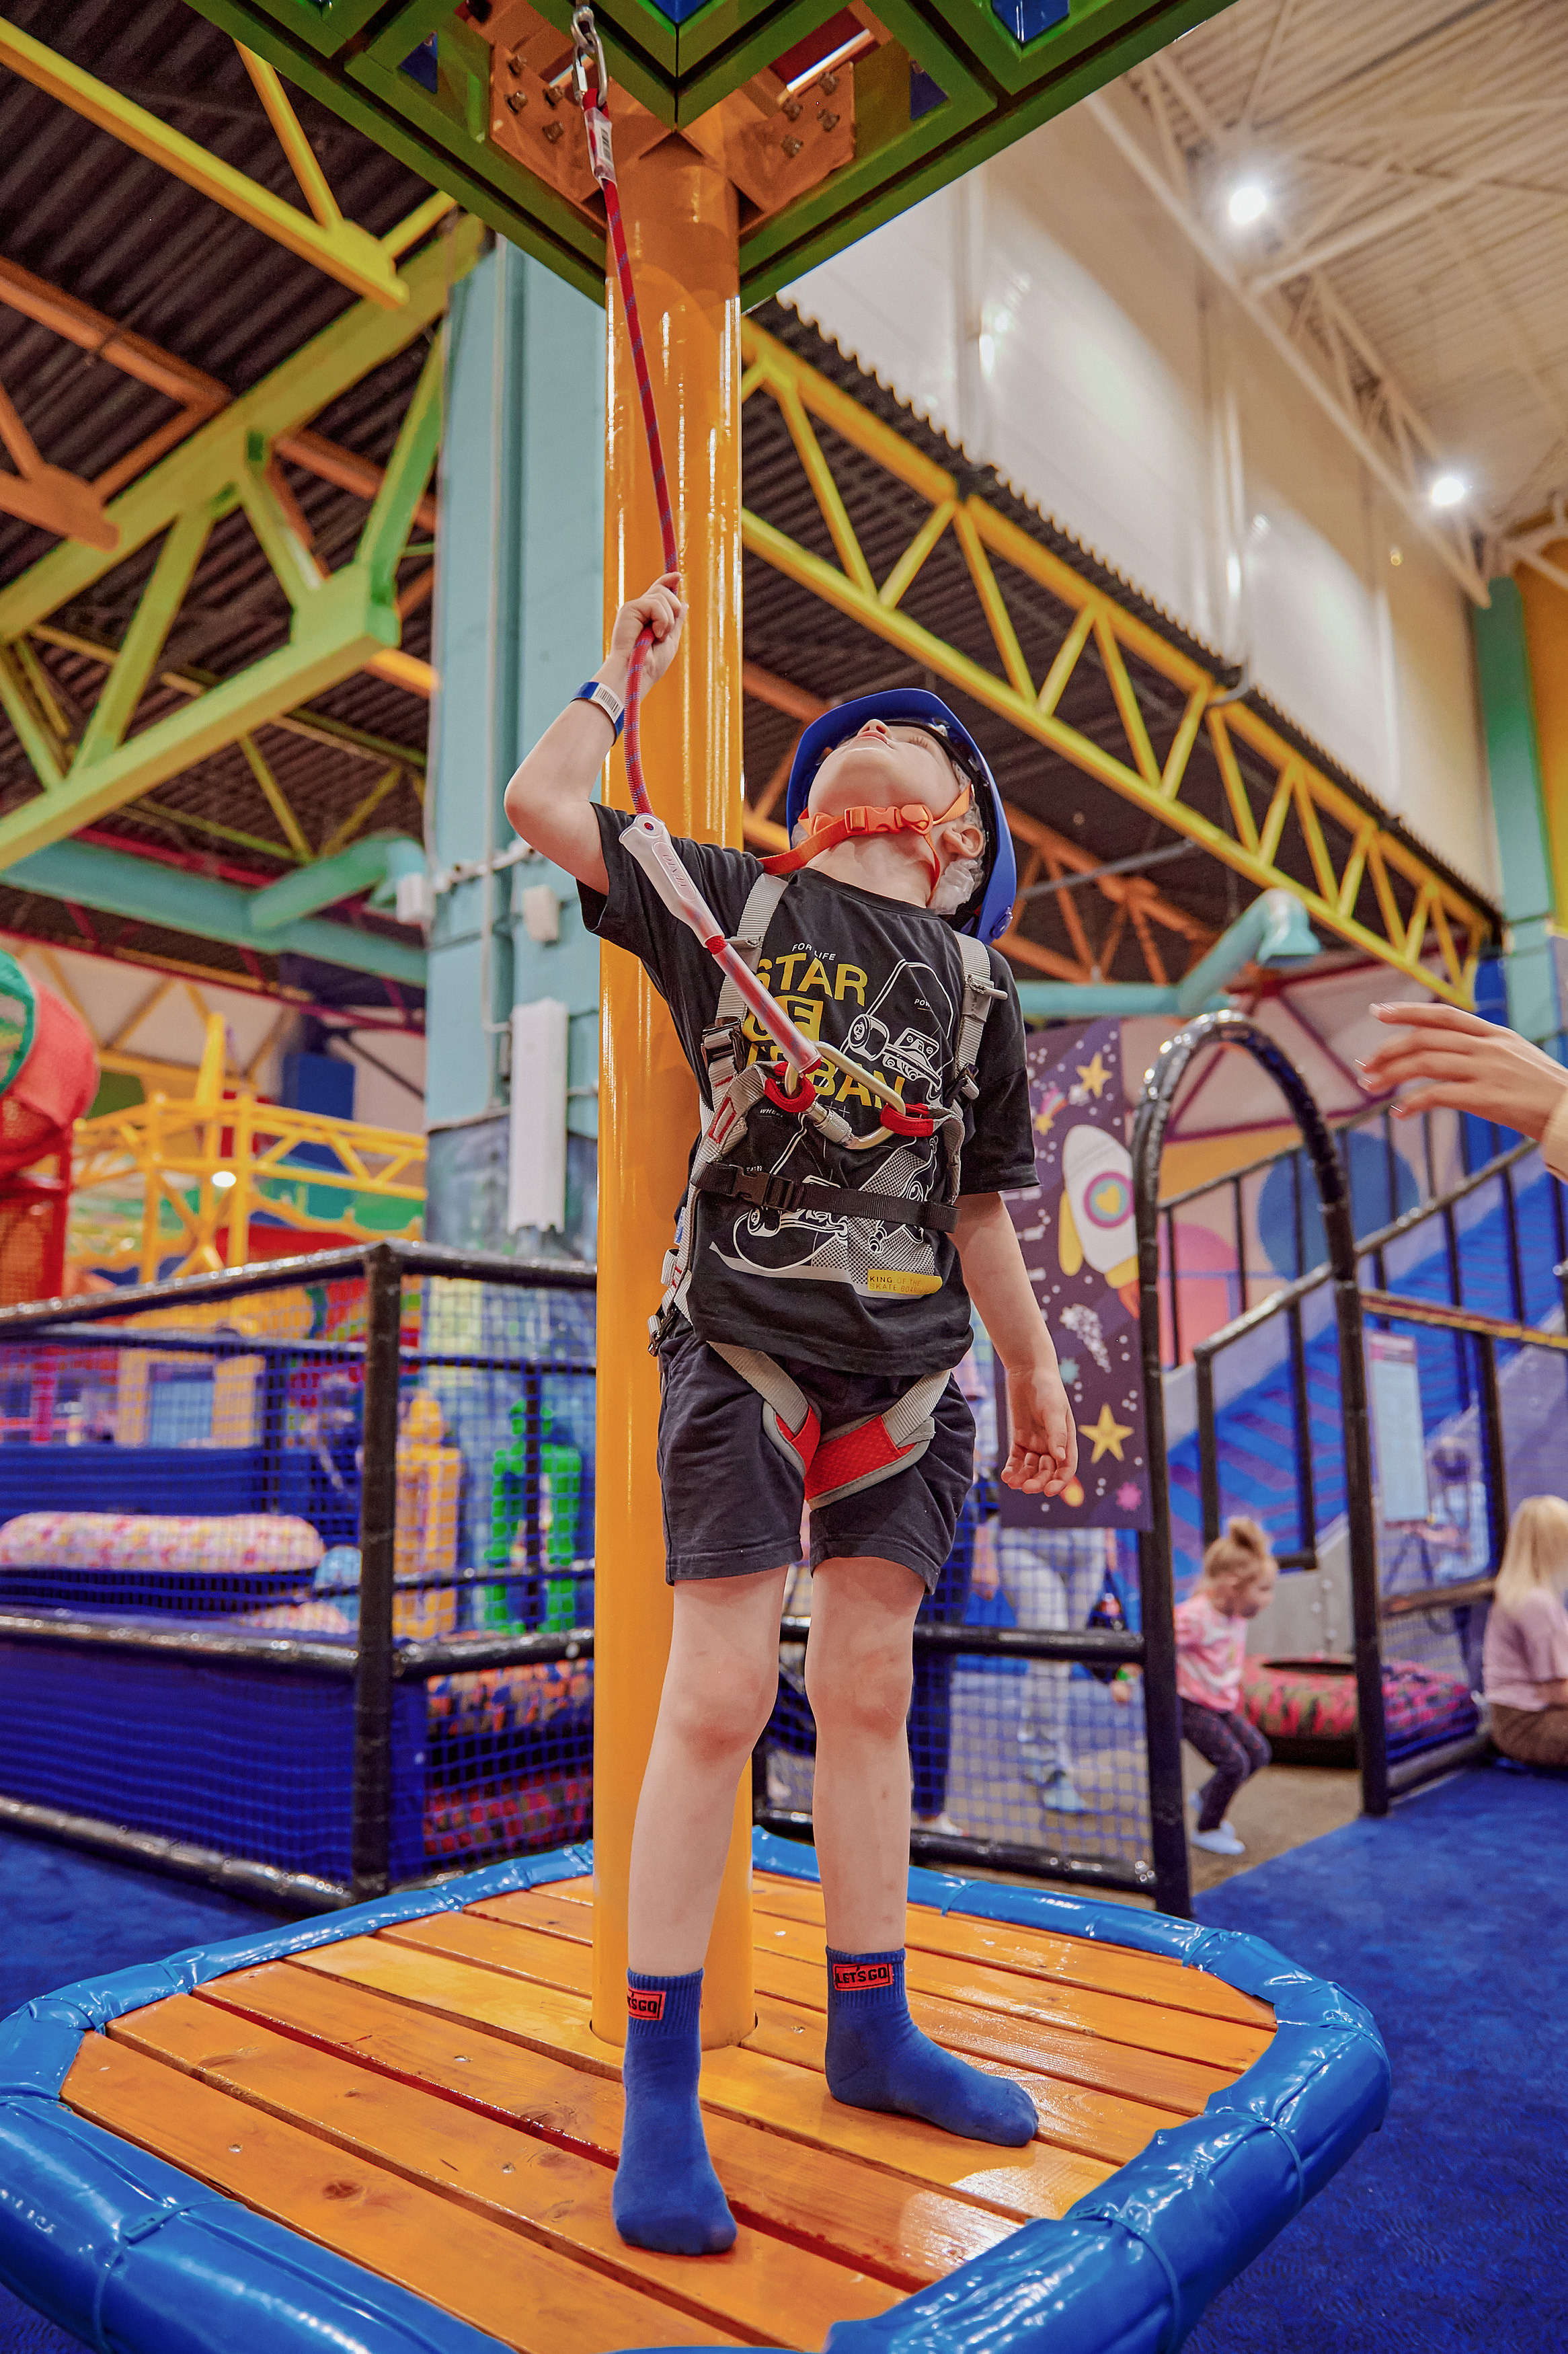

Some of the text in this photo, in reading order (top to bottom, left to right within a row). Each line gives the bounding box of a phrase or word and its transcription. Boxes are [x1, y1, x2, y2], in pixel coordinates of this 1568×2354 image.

[792, 942, 836, 960] FOR LIFE
[756, 952, 868, 1007] STAR
[869, 1283, 897, 1291] SKATE
